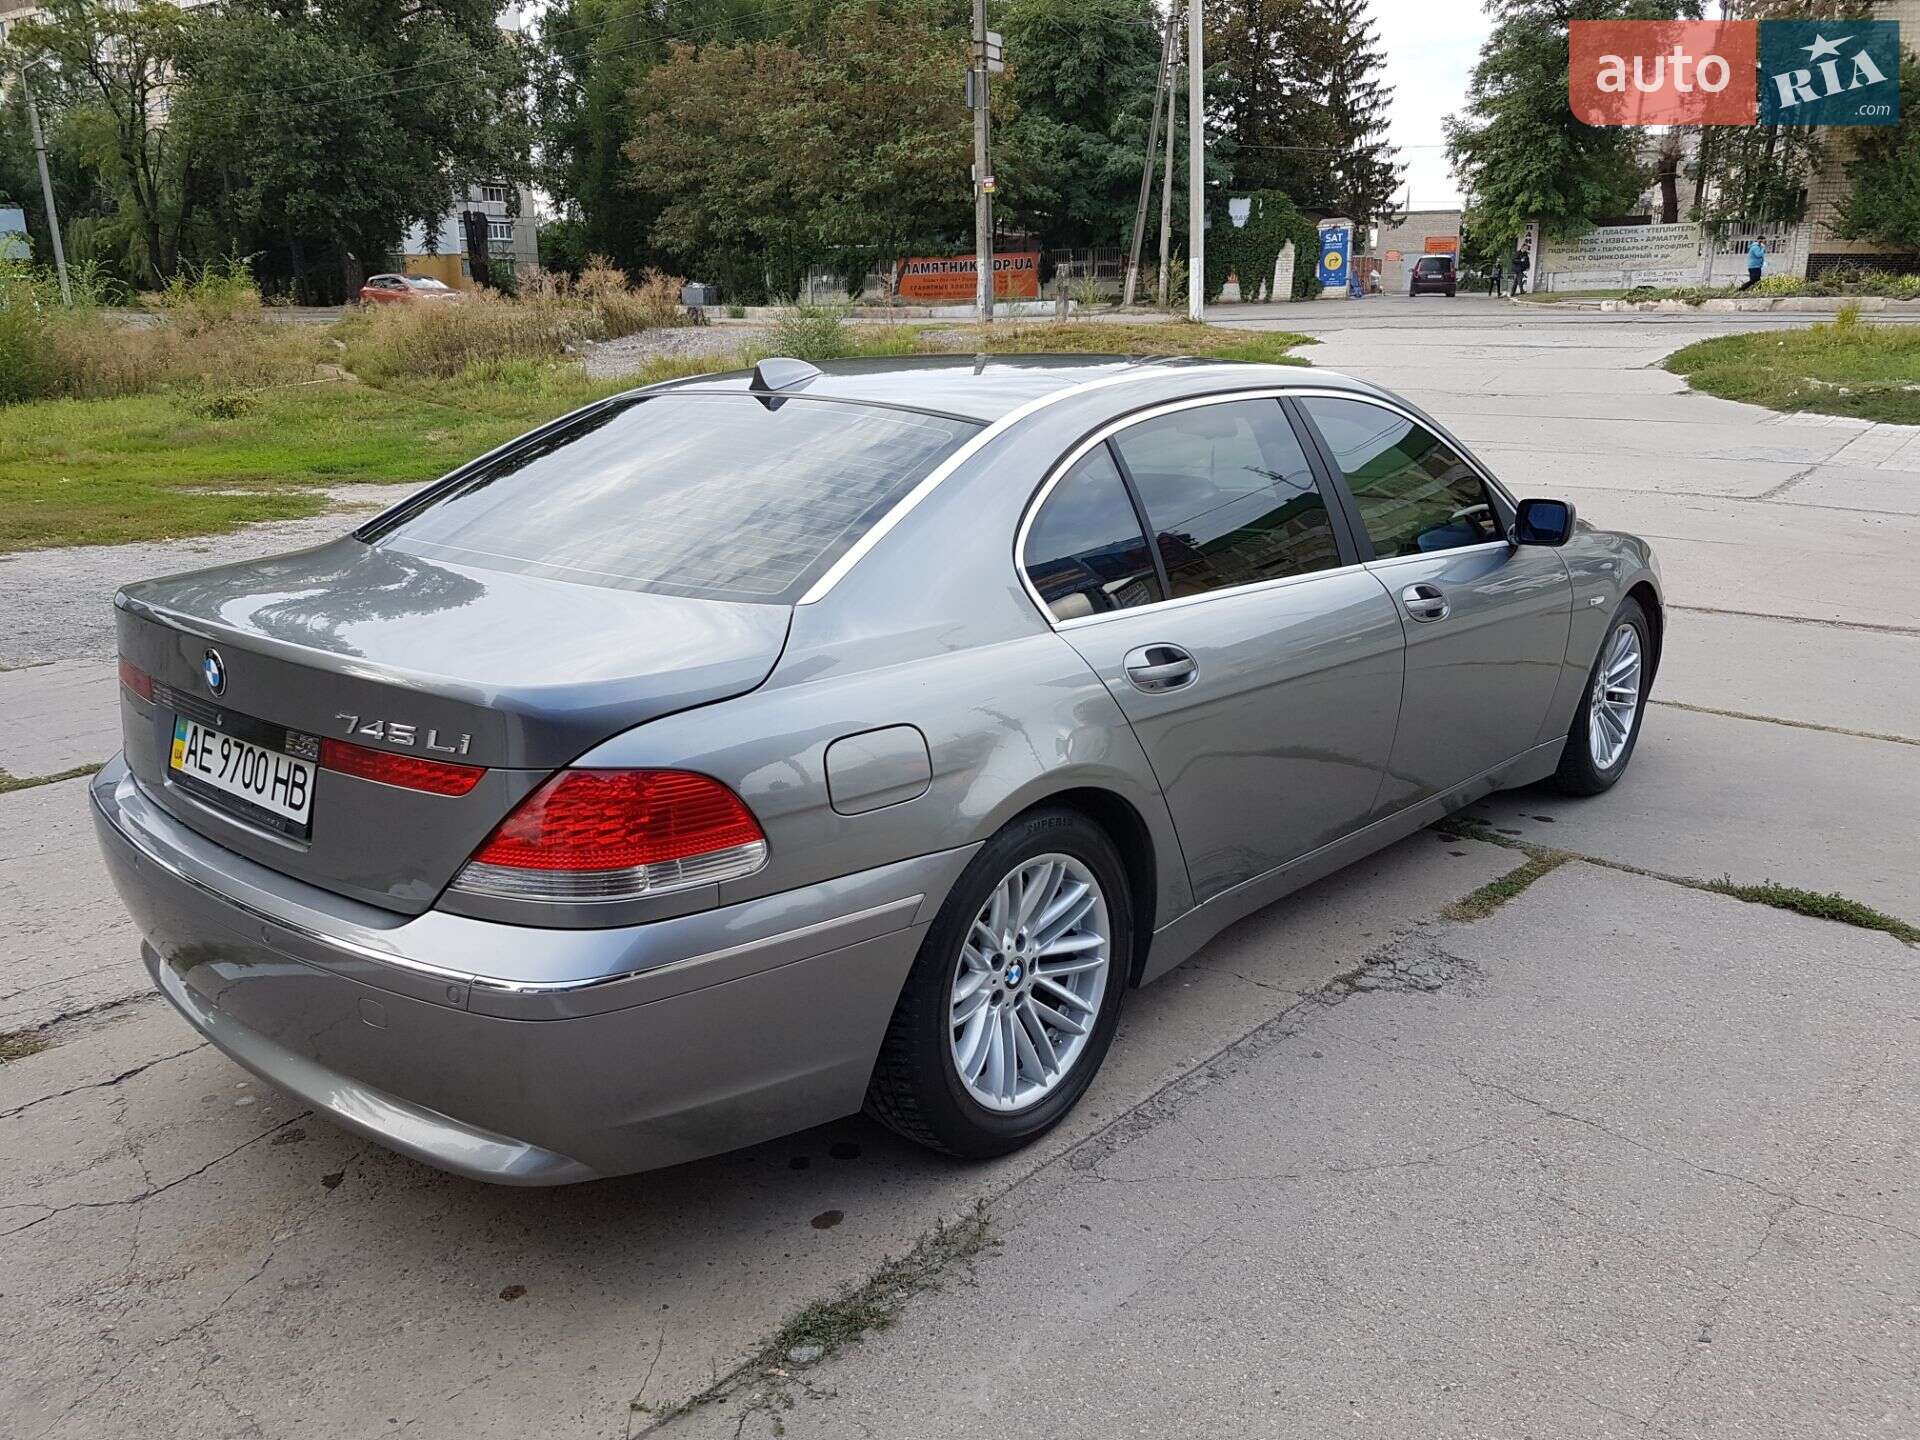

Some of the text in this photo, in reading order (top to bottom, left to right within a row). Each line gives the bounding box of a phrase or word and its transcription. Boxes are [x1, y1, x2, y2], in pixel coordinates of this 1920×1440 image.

[1325, 233, 1343, 243] SAT
[335, 713, 417, 746] 745
[185, 725, 307, 811] AE 9700 HB
